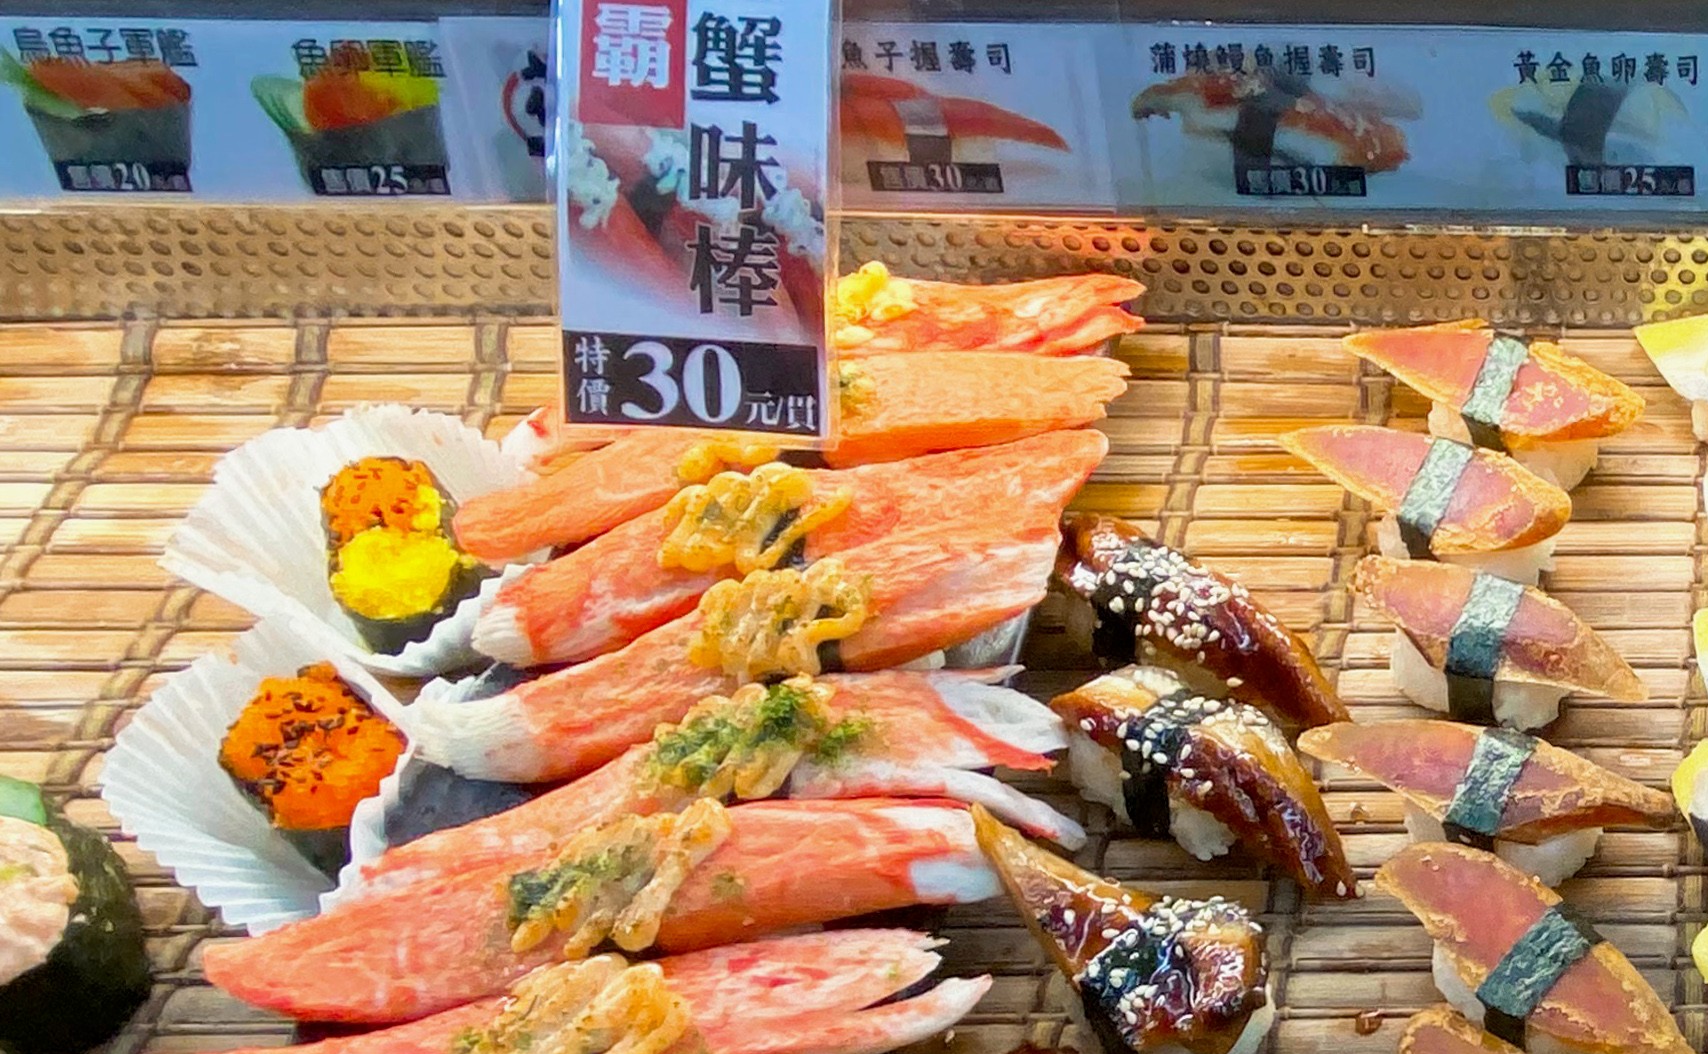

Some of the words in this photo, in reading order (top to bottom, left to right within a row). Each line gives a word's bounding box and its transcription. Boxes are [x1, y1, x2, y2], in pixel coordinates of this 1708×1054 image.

[688, 10, 783, 316] 蟹味棒
[574, 335, 614, 417] 特價
